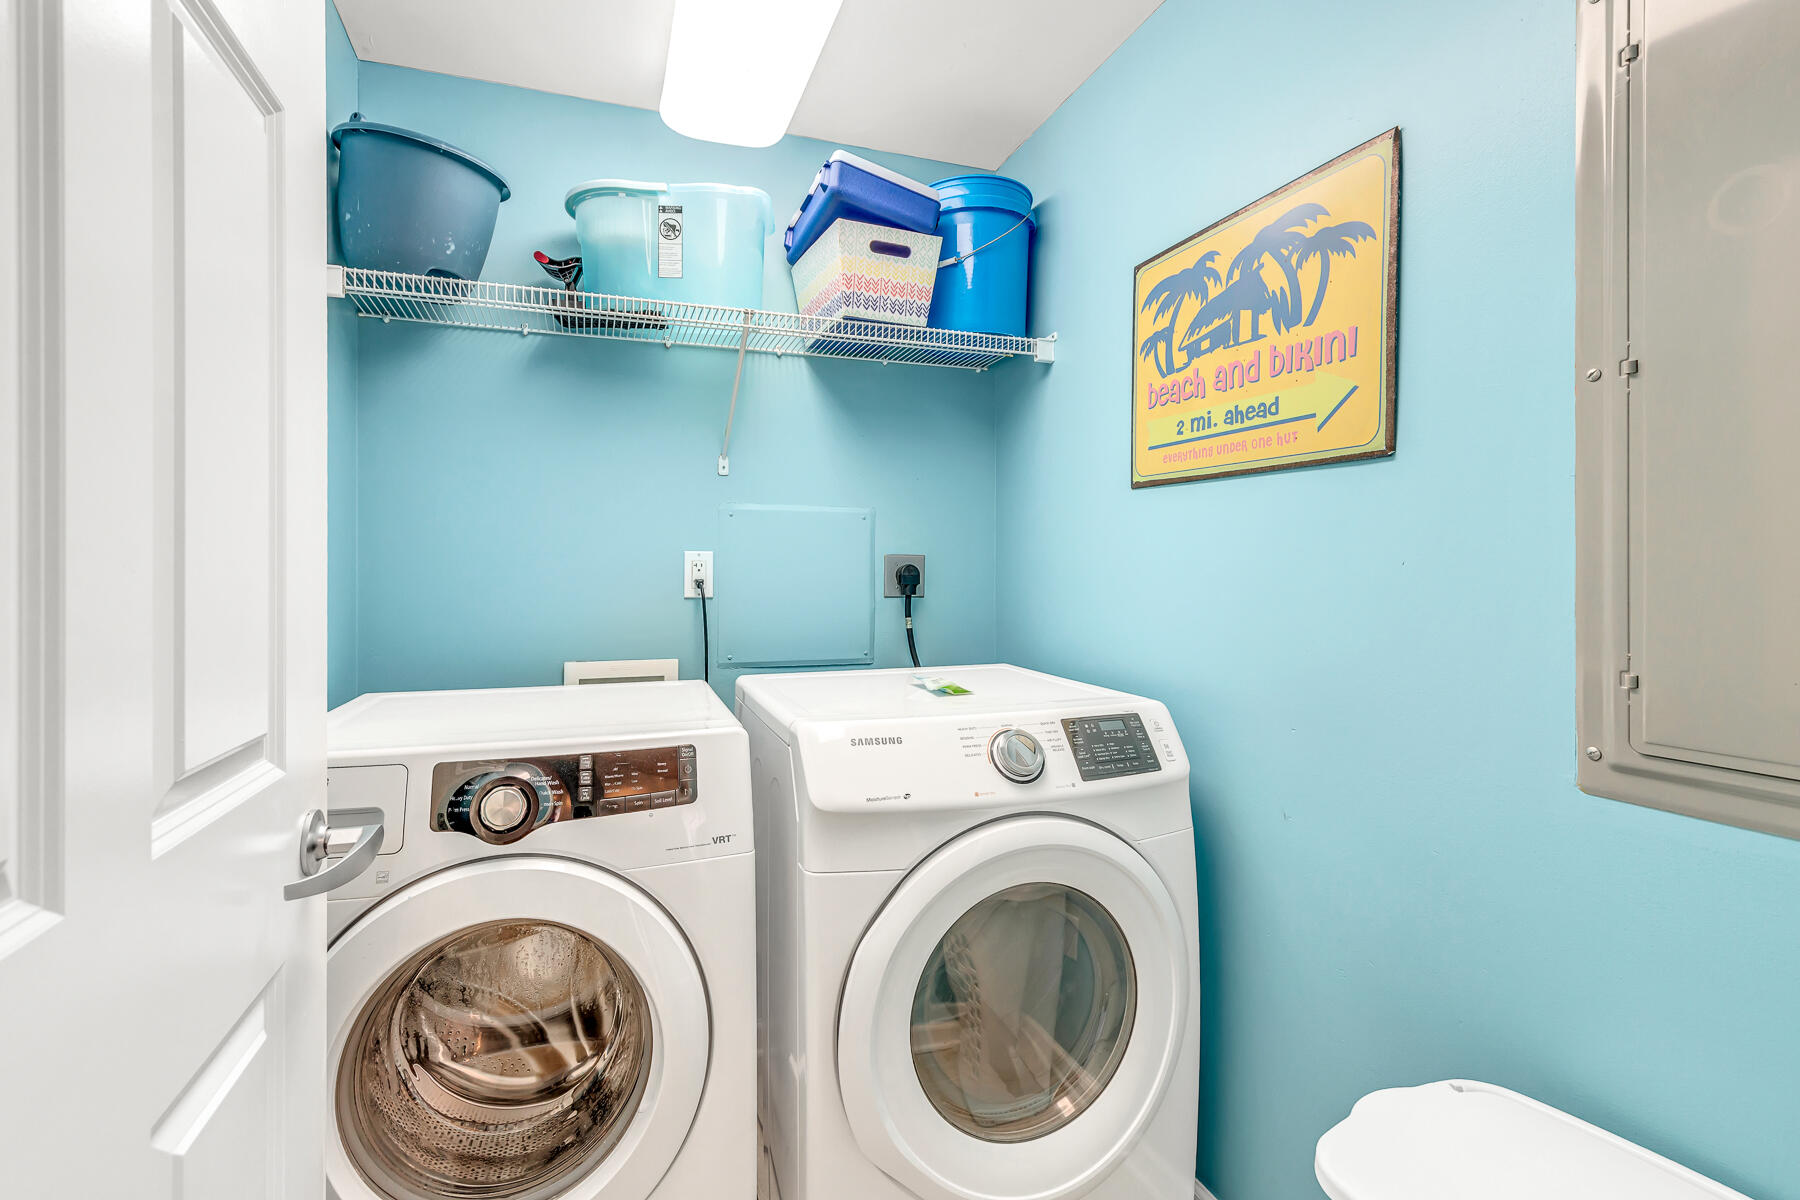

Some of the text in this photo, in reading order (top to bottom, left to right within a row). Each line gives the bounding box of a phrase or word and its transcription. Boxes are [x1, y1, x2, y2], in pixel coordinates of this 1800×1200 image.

[1147, 368, 1206, 410] beach
[1212, 350, 1261, 392] and
[1176, 396, 1280, 436] 2 mi. ahead
[850, 736, 903, 747] SAMSUNG
